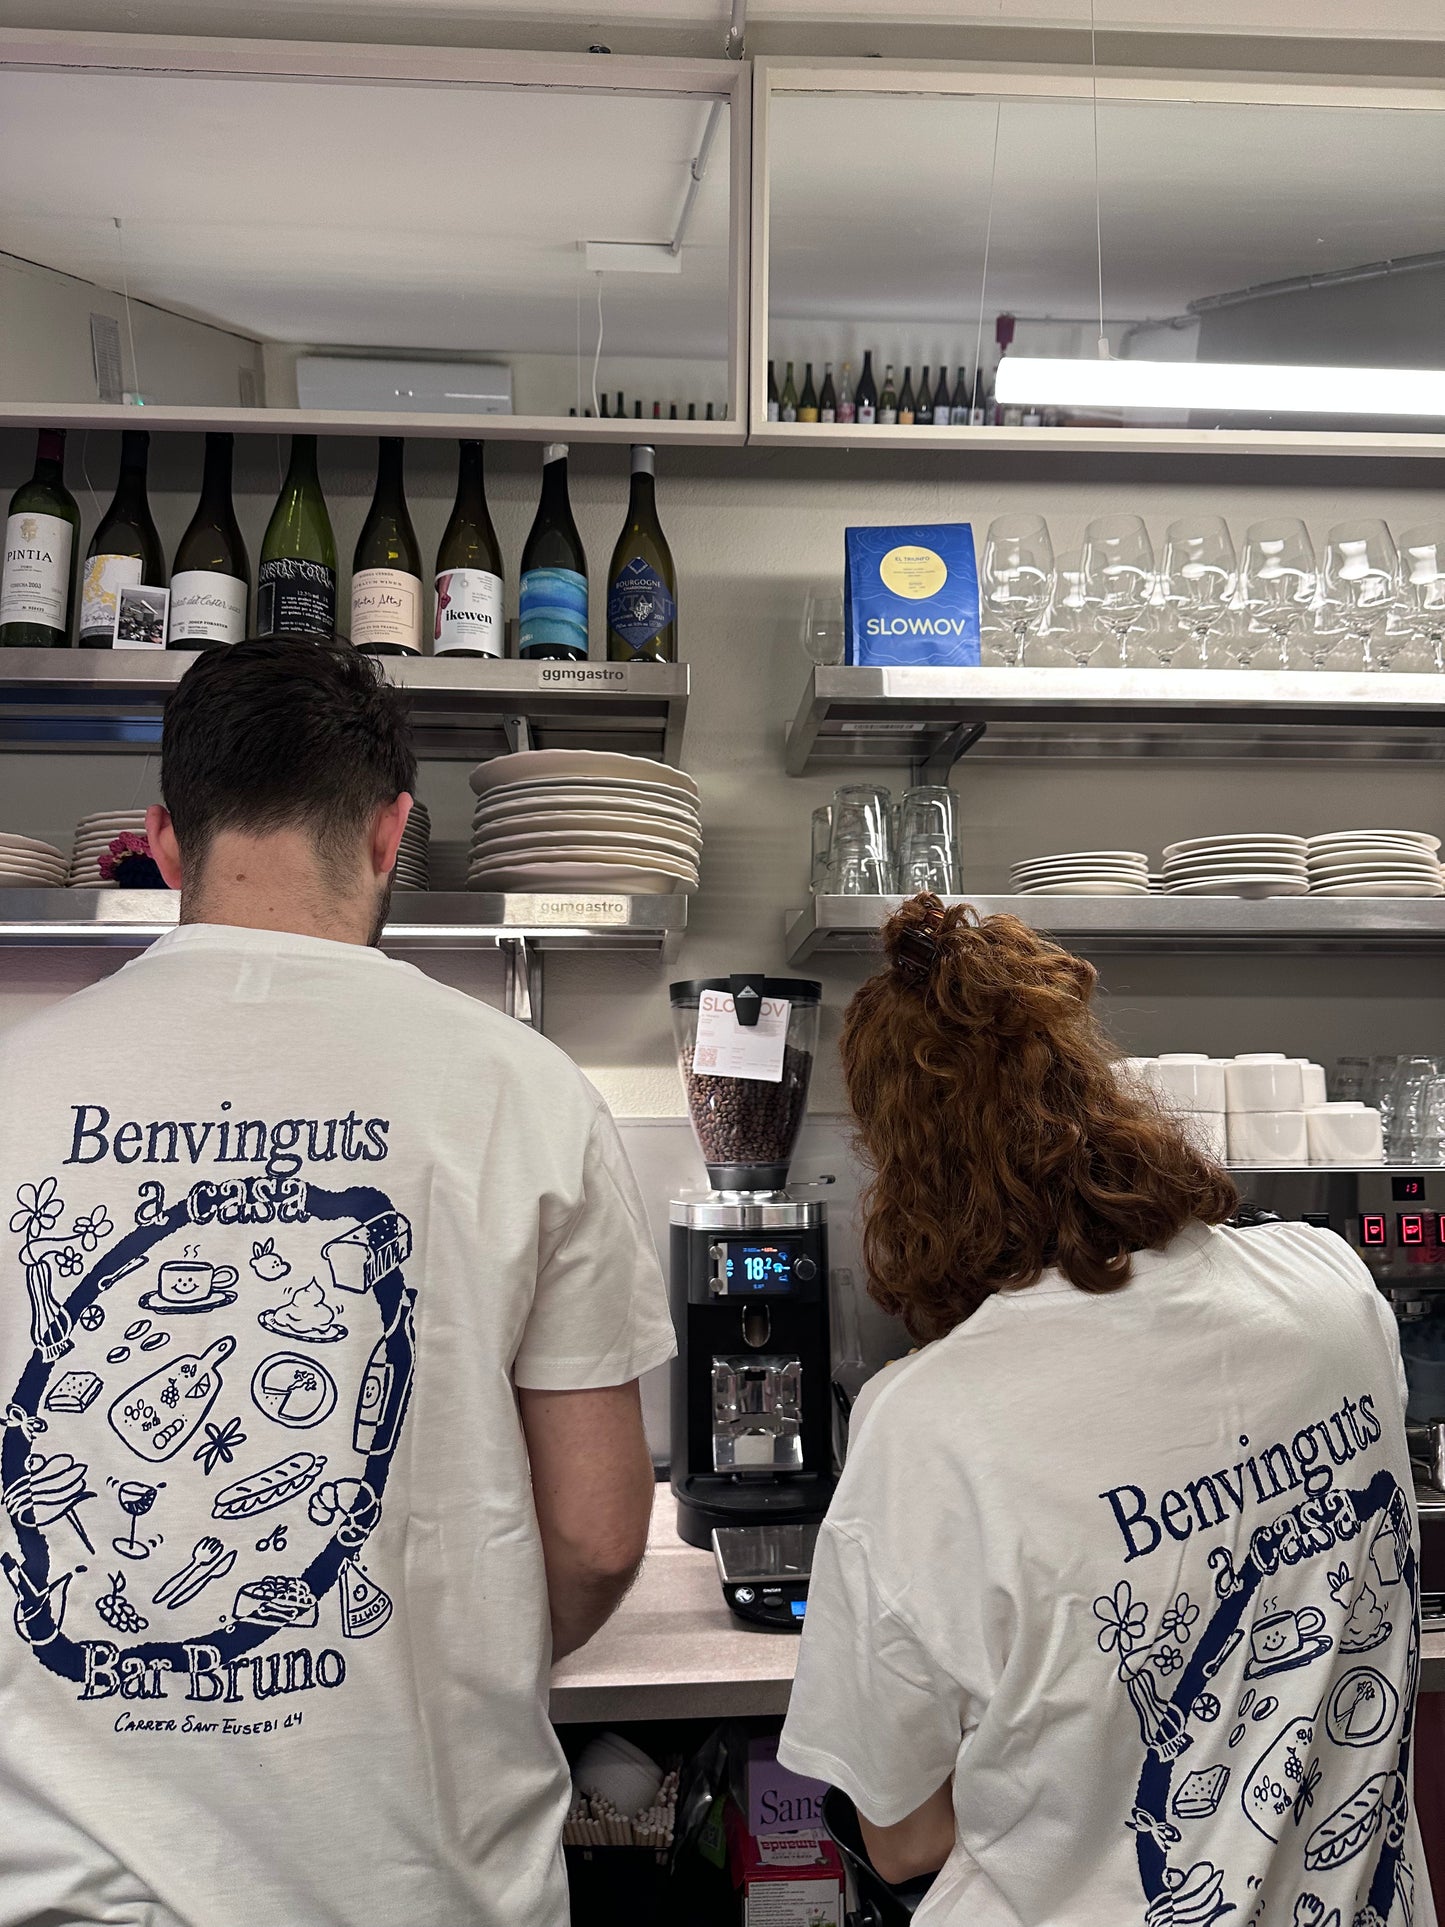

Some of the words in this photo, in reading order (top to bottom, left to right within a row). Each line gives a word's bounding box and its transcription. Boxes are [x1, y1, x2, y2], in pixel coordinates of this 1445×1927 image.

[7, 549, 53, 563] PINTIA
[615, 578, 662, 589] BOURGOGNE
[376, 593, 403, 609] Altas
[446, 609, 493, 625] ikewen
[542, 669, 625, 682] ggmgastro
[540, 901, 624, 915] ggmgastro
[702, 996, 786, 1018] SLOOV
[62, 1100, 390, 1178] Benvinguts
[1405, 1182, 1418, 1193] 13
[135, 1180, 169, 1227] a
[185, 1177, 311, 1226] casa
[744, 1256, 765, 1281] 18
[1098, 1393, 1382, 1563] Benvinguts
[1207, 1546, 1243, 1598] a
[1248, 1490, 1362, 1575] casa
[351, 1597, 387, 1625] COMTE
[77, 1639, 172, 1701] Bar
[181, 1643, 346, 1703] Bruno
[114, 1712, 177, 1732] CARRER
[182, 1714, 219, 1733] SANT
[221, 1718, 279, 1735] EUSEBI
[760, 1789, 824, 1826] Sans
[760, 1840, 818, 1852] amanda
